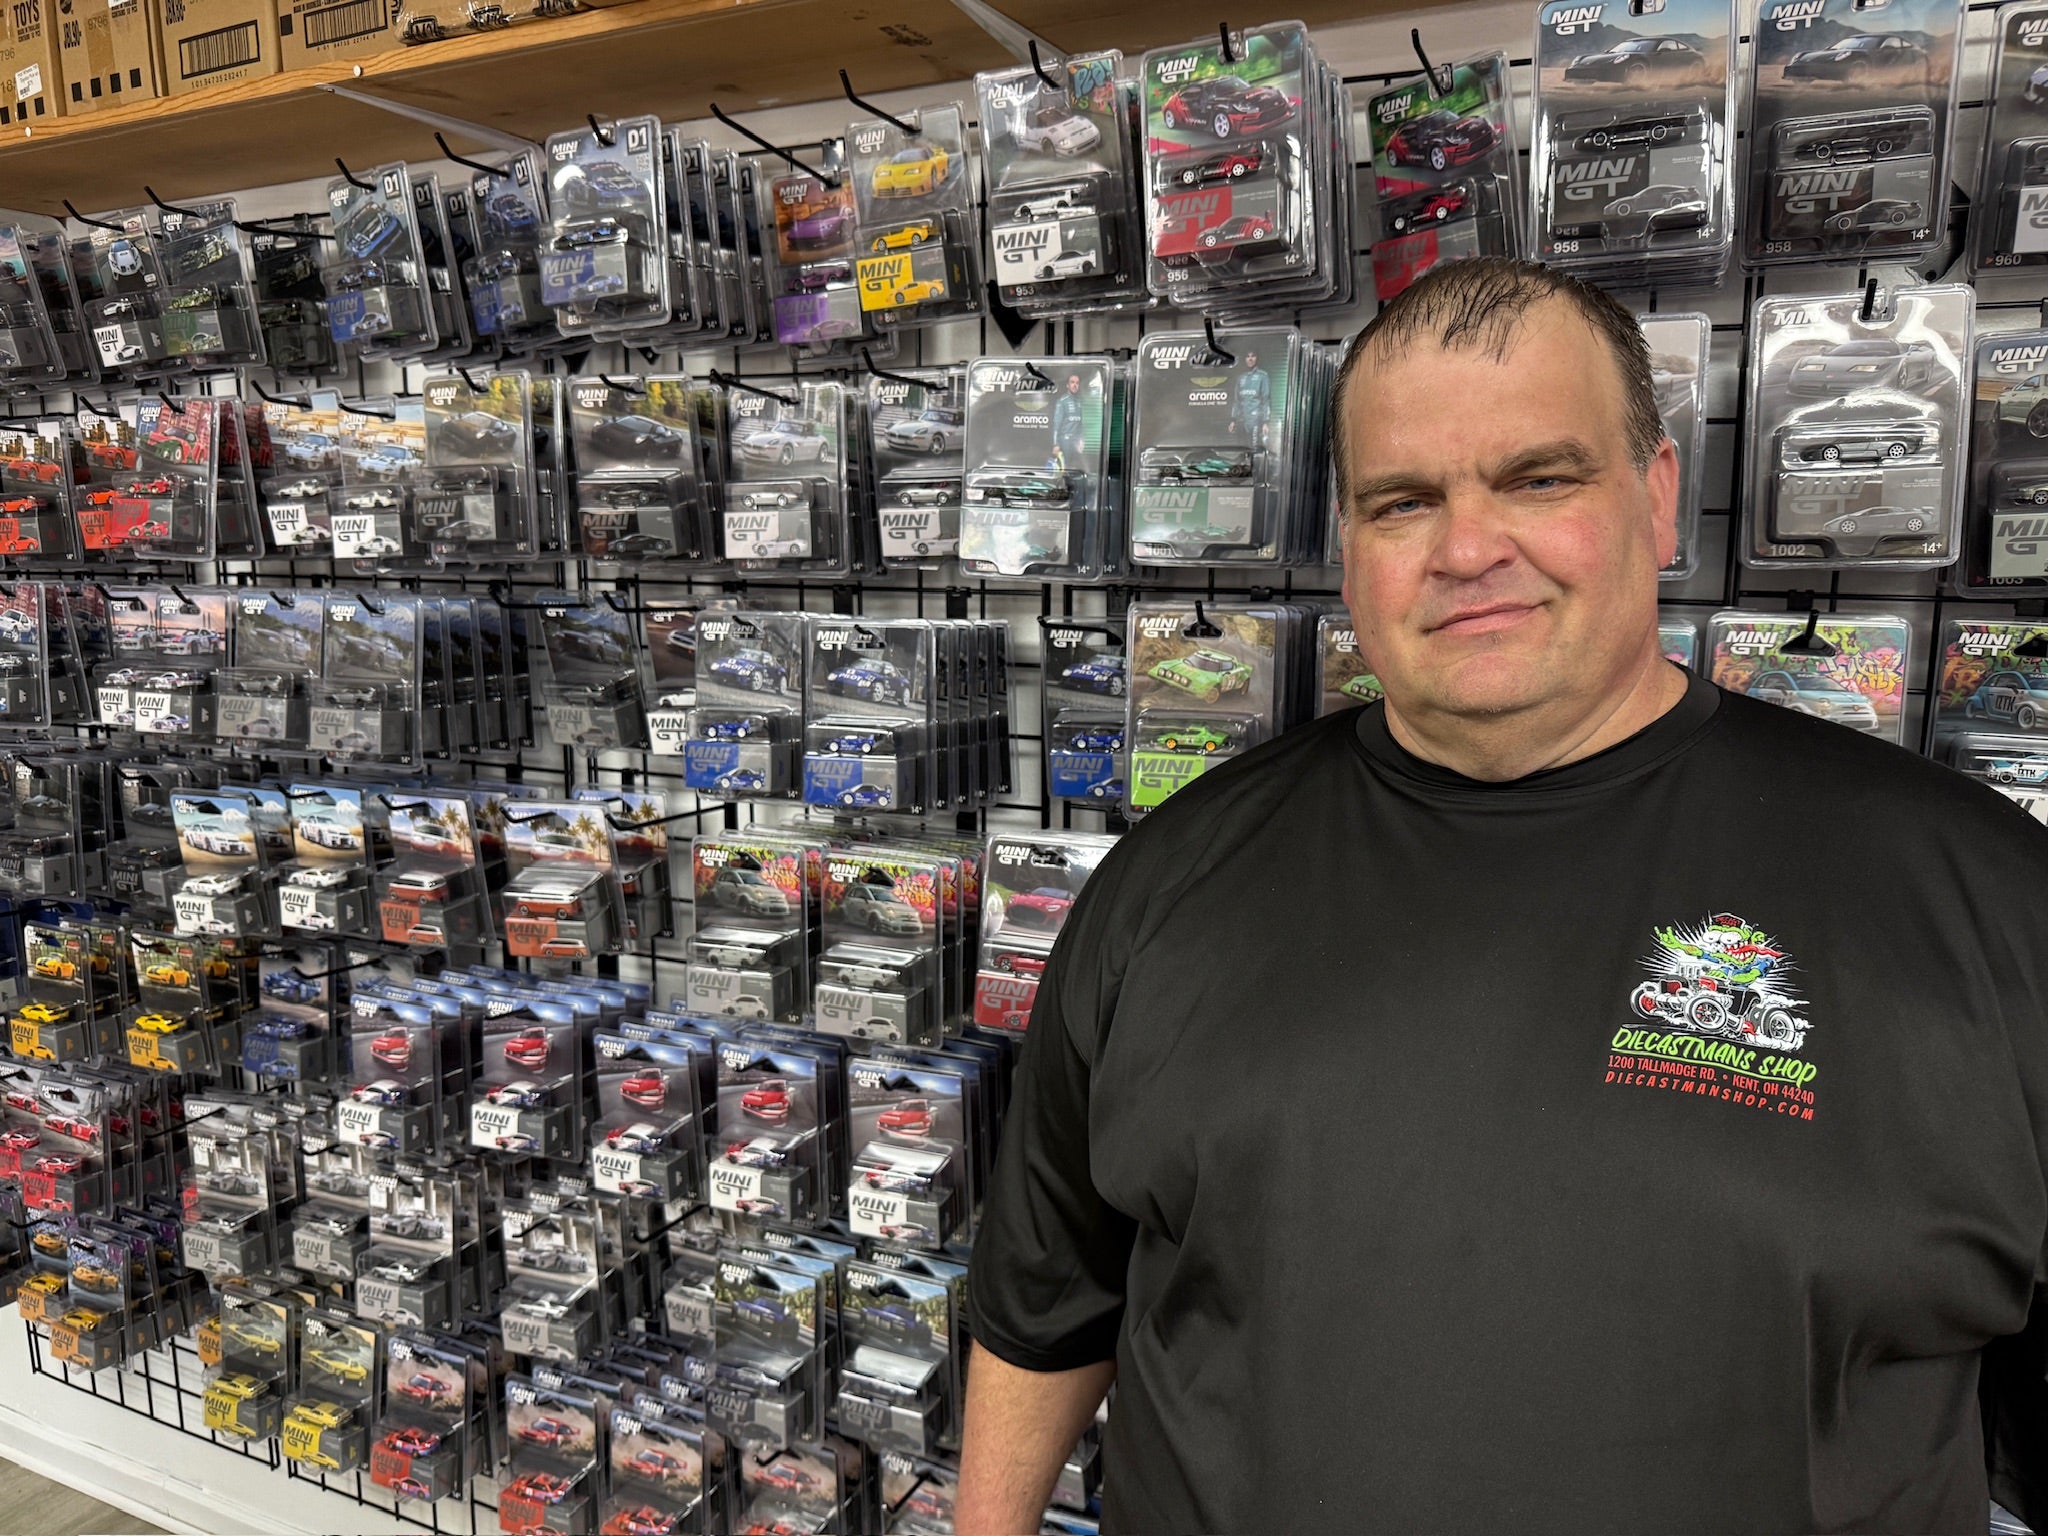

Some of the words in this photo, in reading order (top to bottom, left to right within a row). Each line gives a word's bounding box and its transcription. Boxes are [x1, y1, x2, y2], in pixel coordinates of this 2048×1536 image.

[14, 0, 40, 28] TOYS
[1551, 5, 1603, 25] MINI
[1771, 1, 1824, 20] MINI
[1555, 19, 1600, 35] GT
[1775, 16, 1821, 32] GT
[1157, 57, 1199, 74] MINI
[1161, 68, 1195, 83] GT
[1377, 94, 1413, 115] MINI
[1381, 107, 1408, 124] GT
[627, 128, 648, 147] D1
[855, 130, 886, 146] MINI
[552, 141, 579, 155] MINI
[1556, 157, 1637, 184] MINI
[383, 173, 400, 194] D1
[1564, 176, 1631, 201] GT
[1777, 171, 1860, 197] MINI
[329, 189, 350, 200] MINI
[780, 184, 808, 198] MINI
[1784, 189, 1853, 214] GT
[162, 213, 183, 224] MINI
[996, 228, 1050, 249] MINI
[1696, 227, 1716, 239] 14+
[1911, 228, 1931, 240] 14+
[1009, 245, 1048, 264] GT
[1553, 242, 1580, 255] 958
[1766, 242, 1792, 254] 958
[1284, 253, 1300, 266] 14+
[1995, 253, 2021, 267] 960
[543, 257, 587, 276] MINI
[860, 258, 904, 278] MINI
[1167, 270, 1189, 281] 956
[865, 274, 901, 292] GT
[1015, 287, 1035, 298] 953
[96, 330, 119, 342] MINI
[1150, 346, 1191, 359] MINI
[1990, 345, 2048, 361] MINI
[1153, 356, 1188, 369] GT
[1995, 357, 2044, 374] GT
[430, 387, 457, 397] MINI
[577, 389, 608, 400] MINI
[877, 385, 910, 396] MINI
[1189, 391, 1228, 402] aramco
[581, 398, 606, 408] GT
[736, 399, 766, 409] MINI
[881, 393, 909, 405] GT
[140, 406, 160, 416] MINI
[1014, 416, 1049, 424] aramco
[1142, 490, 1200, 508] MINI
[418, 500, 457, 513] MINI
[271, 508, 299, 520] MINI
[422, 513, 454, 527] GT
[584, 513, 630, 527] MINI
[1142, 507, 1194, 524] GT
[275, 520, 297, 531] GT
[334, 519, 368, 531] MINI
[727, 516, 770, 529] MINI
[883, 515, 930, 528] MINI
[338, 530, 365, 542] GT
[732, 528, 768, 542] GT
[888, 526, 929, 540] GT
[1770, 544, 1807, 557] 1002
[1921, 542, 1942, 555] 14+
[1988, 574, 2024, 586] 1003
[160, 599, 180, 609] MINI
[243, 599, 267, 608] MINI
[331, 605, 356, 614] MINI
[701, 622, 730, 632] MINI
[1140, 617, 1179, 629] MINI
[703, 631, 728, 641] GT
[817, 630, 849, 641] MINI
[1050, 629, 1083, 640] MINI
[1143, 627, 1175, 639] GT
[1726, 630, 1778, 644] MINI
[1958, 632, 2012, 645] MINI
[820, 639, 847, 651] GT
[1053, 638, 1080, 649] GT
[1731, 642, 1776, 656] GT
[1963, 642, 2009, 657] GT
[100, 692, 123, 702] MINI
[137, 696, 164, 707] MINI
[221, 700, 254, 710] MINI
[139, 706, 161, 718] GT
[312, 711, 345, 723] MINI
[687, 746, 732, 759] MINI
[807, 759, 854, 774] MINI
[1135, 758, 1193, 773] MINI
[1140, 773, 1188, 789] GT
[700, 848, 729, 858] MINI
[996, 844, 1031, 856] MINI
[702, 857, 727, 867] GT
[999, 853, 1028, 866] GT
[829, 863, 860, 874] MINI
[832, 872, 858, 883] GT
[282, 892, 309, 904] MINI
[176, 900, 206, 912] MINI
[286, 903, 309, 914] GT
[180, 910, 205, 921] GT
[689, 972, 731, 988] MINI
[980, 978, 1030, 995] MINI
[693, 984, 729, 998] GT
[818, 990, 862, 1007] MINI
[983, 993, 1026, 1010] GT
[355, 1000, 378, 1012] MINI
[823, 1005, 860, 1020] GT
[12, 1025, 33, 1037] MINI
[129, 1036, 153, 1048] MINI
[723, 1049, 751, 1062] MINI
[1611, 1027, 1757, 1071] DIECASTMANS
[1759, 1055, 1817, 1088] SHOP
[1608, 1055, 1635, 1070] 1200
[1637, 1058, 1697, 1080] TALLMADGE
[1699, 1068, 1717, 1081] RD.
[1732, 1074, 1761, 1094] KENT,
[1763, 1081, 1780, 1096] OH
[1781, 1085, 1815, 1105] 44240
[1604, 1072, 1815, 1121] DIECASTMANSHOP.COM
[340, 1107, 373, 1121] MINI
[474, 1111, 511, 1125] MINI
[344, 1118, 370, 1132] GT
[479, 1121, 509, 1136] GT
[595, 1154, 632, 1169] MINI
[599, 1164, 631, 1180] GT
[712, 1169, 752, 1186] MINI
[716, 1182, 750, 1198] GT
[852, 1194, 898, 1212] MINI
[857, 1209, 895, 1224] GT
[185, 1238, 213, 1250] MINI
[295, 1239, 325, 1251] MINI
[721, 1263, 748, 1279] MINI
[360, 1284, 393, 1298] MINI
[363, 1296, 391, 1309] GT
[52, 1328, 74, 1341] MINI
[504, 1320, 540, 1336] MINI
[205, 1398, 231, 1412] MINI
[208, 1407, 227, 1421] GT
[285, 1425, 314, 1442] MINI
[288, 1434, 311, 1450] GT
